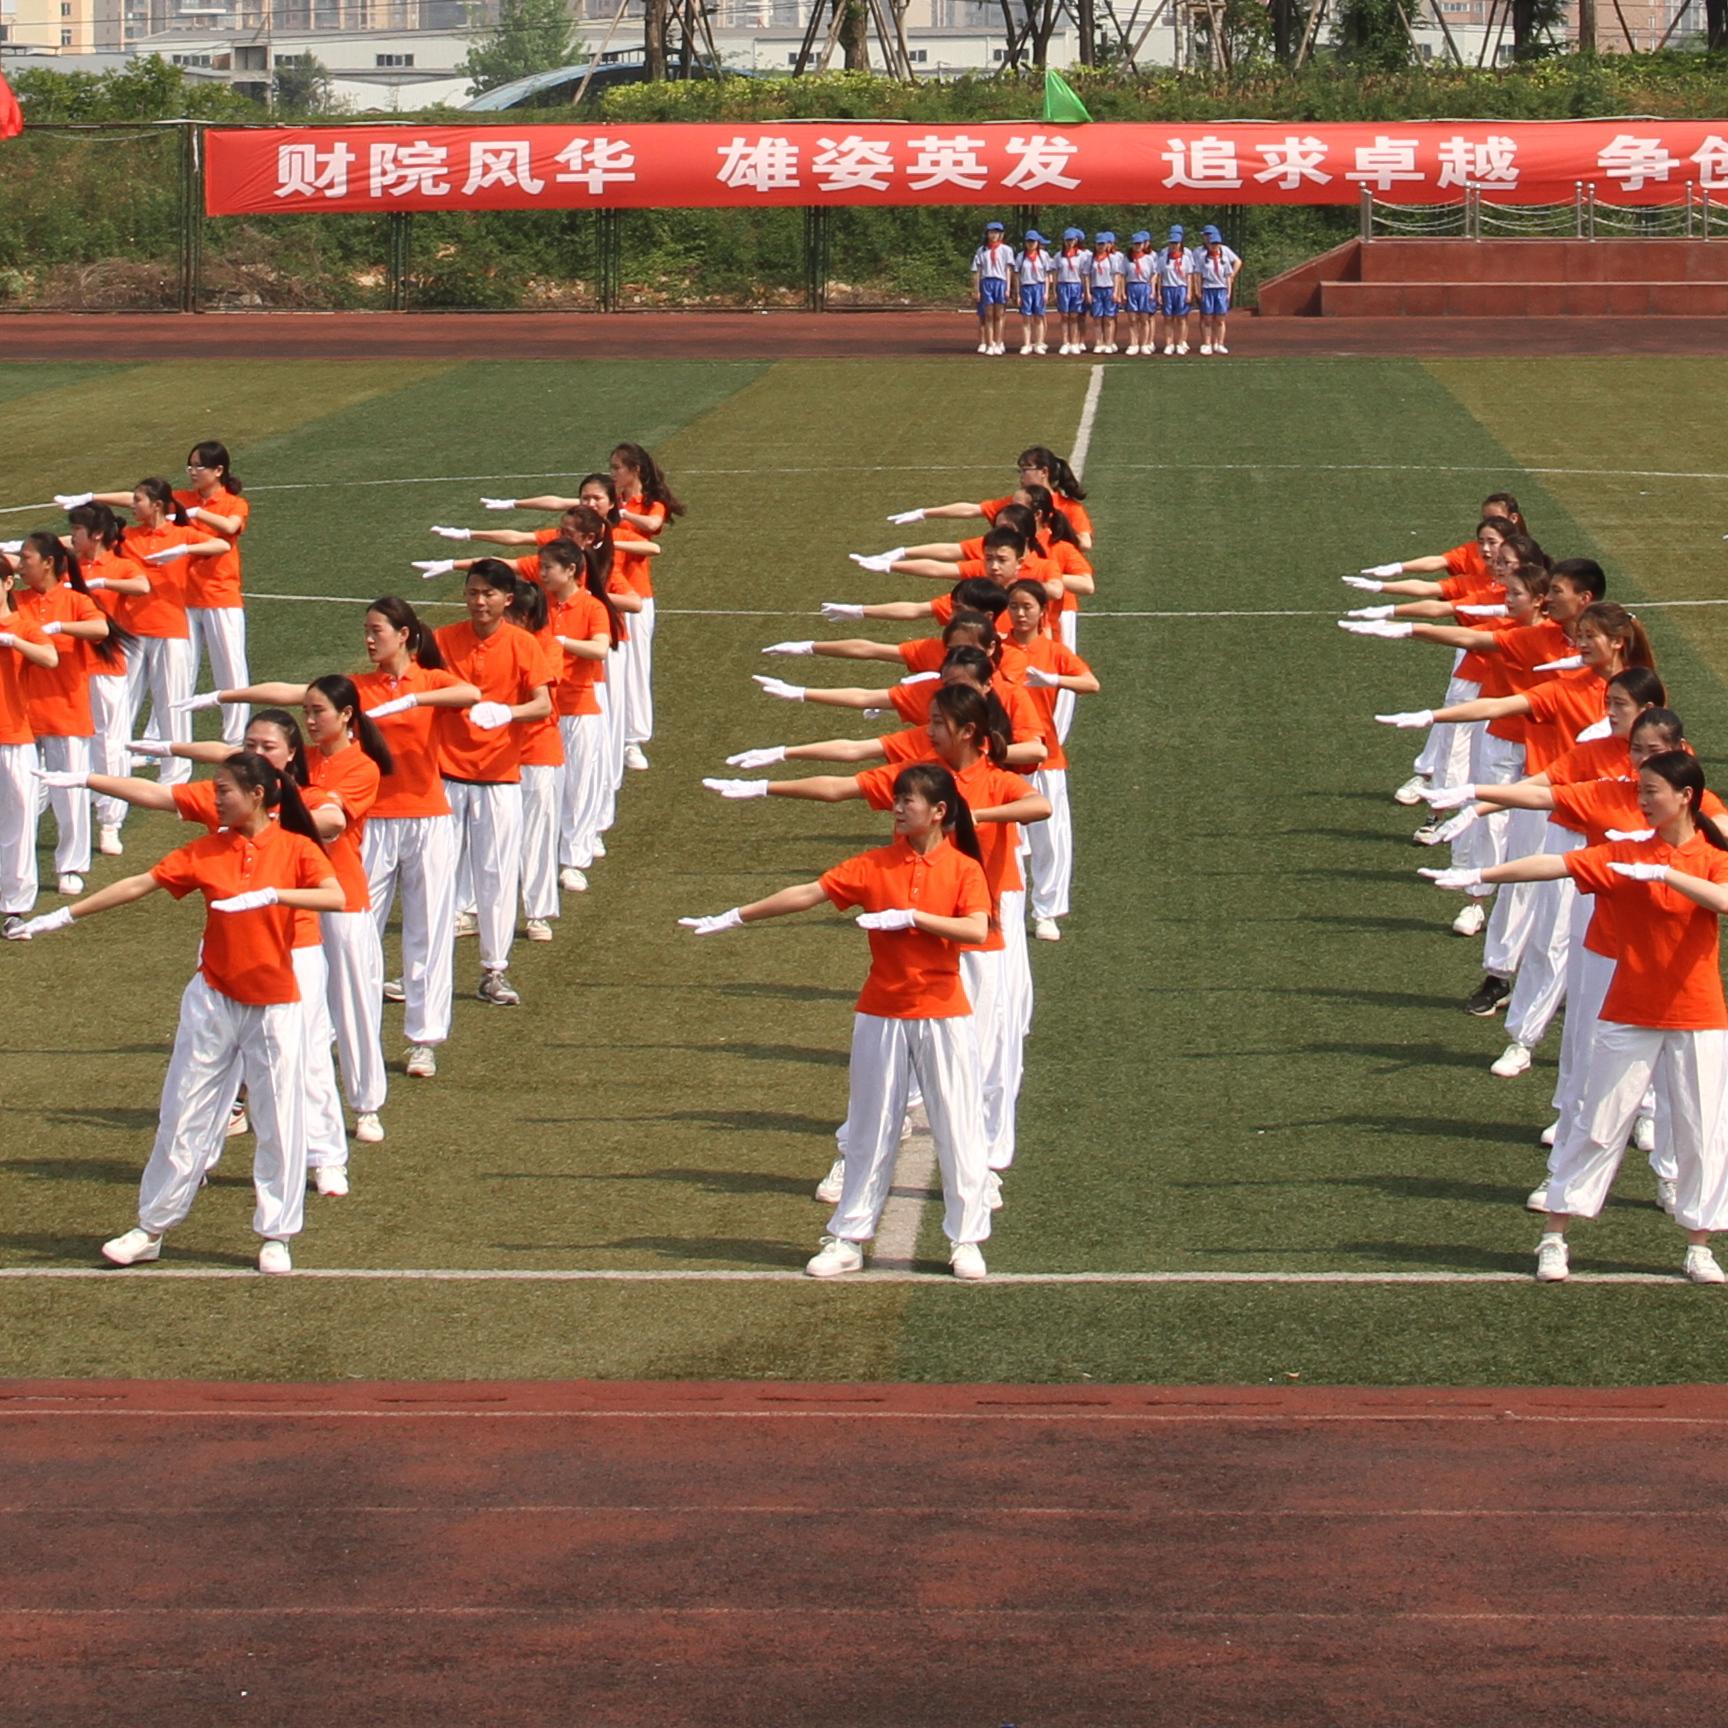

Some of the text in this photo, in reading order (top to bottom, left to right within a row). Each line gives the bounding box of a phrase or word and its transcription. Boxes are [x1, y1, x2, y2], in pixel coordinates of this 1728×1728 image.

[273, 137, 636, 198] 财院风华
[716, 134, 1081, 192] 雄姿英发
[1160, 134, 1520, 191] 追求卓越
